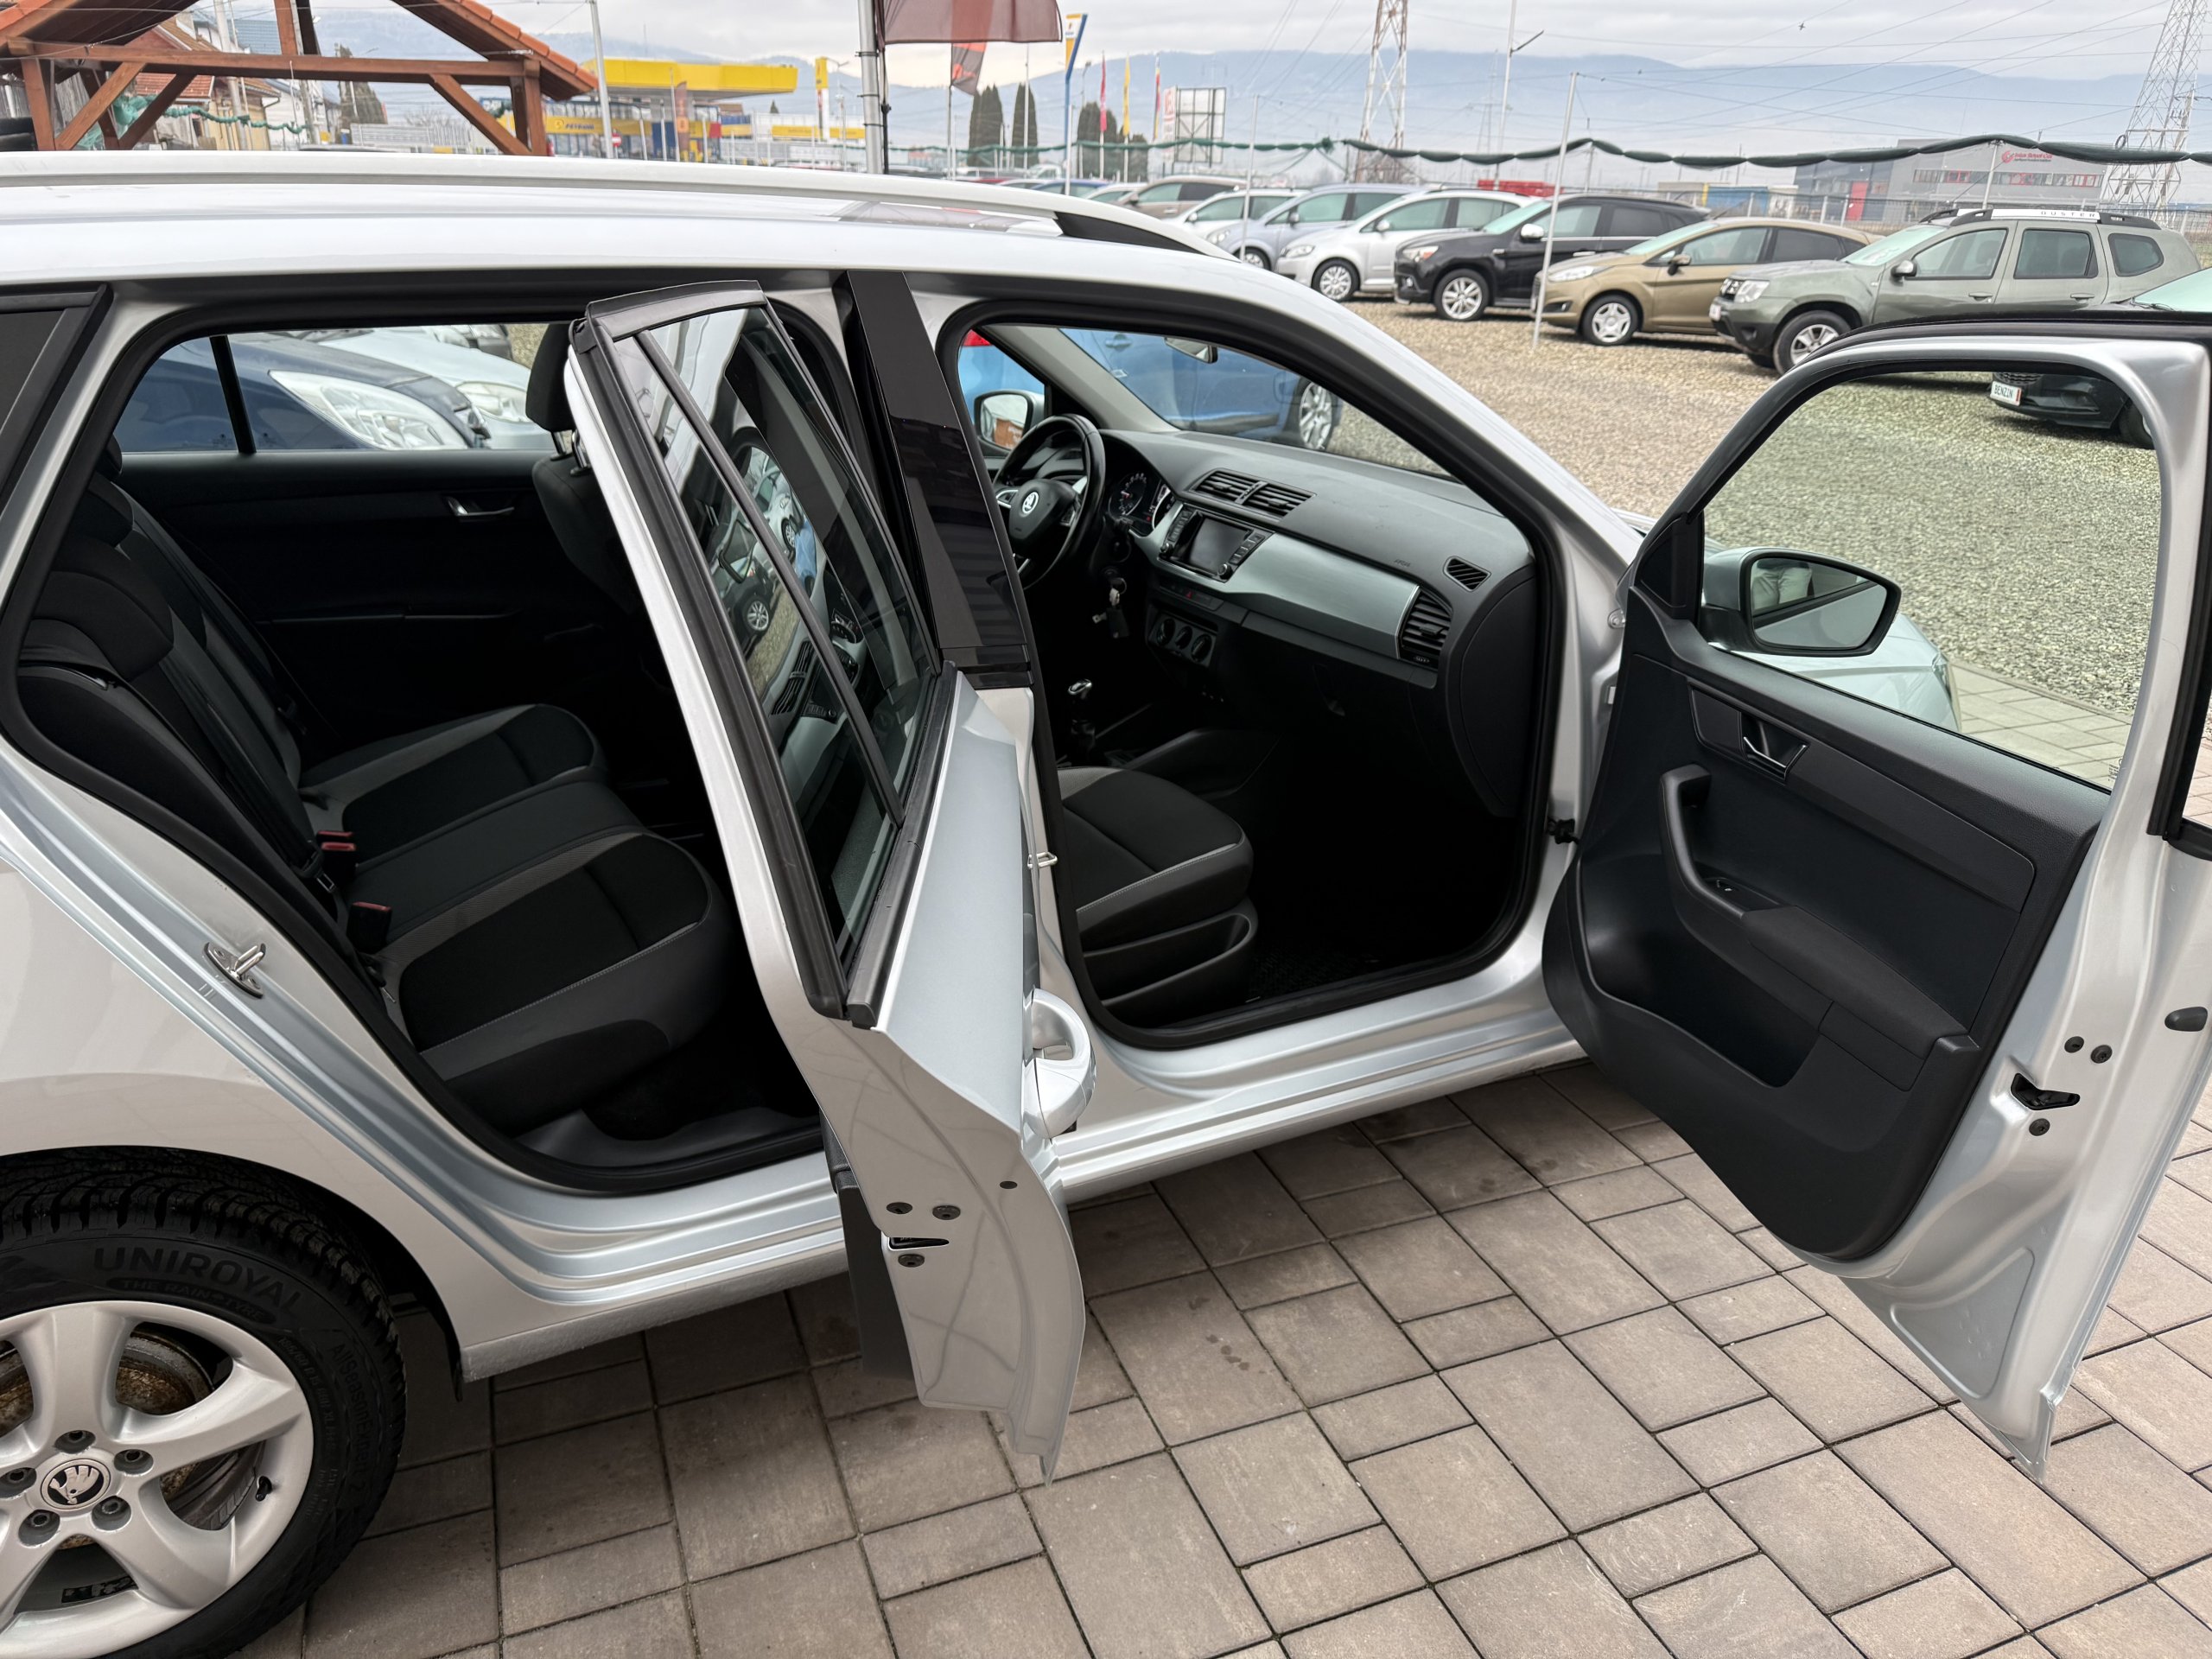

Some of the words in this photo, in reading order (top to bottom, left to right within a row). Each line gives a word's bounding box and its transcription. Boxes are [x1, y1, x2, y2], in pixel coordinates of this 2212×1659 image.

[1994, 384, 2013, 398] BENZIN
[93, 1246, 305, 1319] UNIROYAL
[122, 1280, 160, 1291] THE
[164, 1284, 210, 1300] RAIN
[226, 1299, 266, 1321] TYRE
